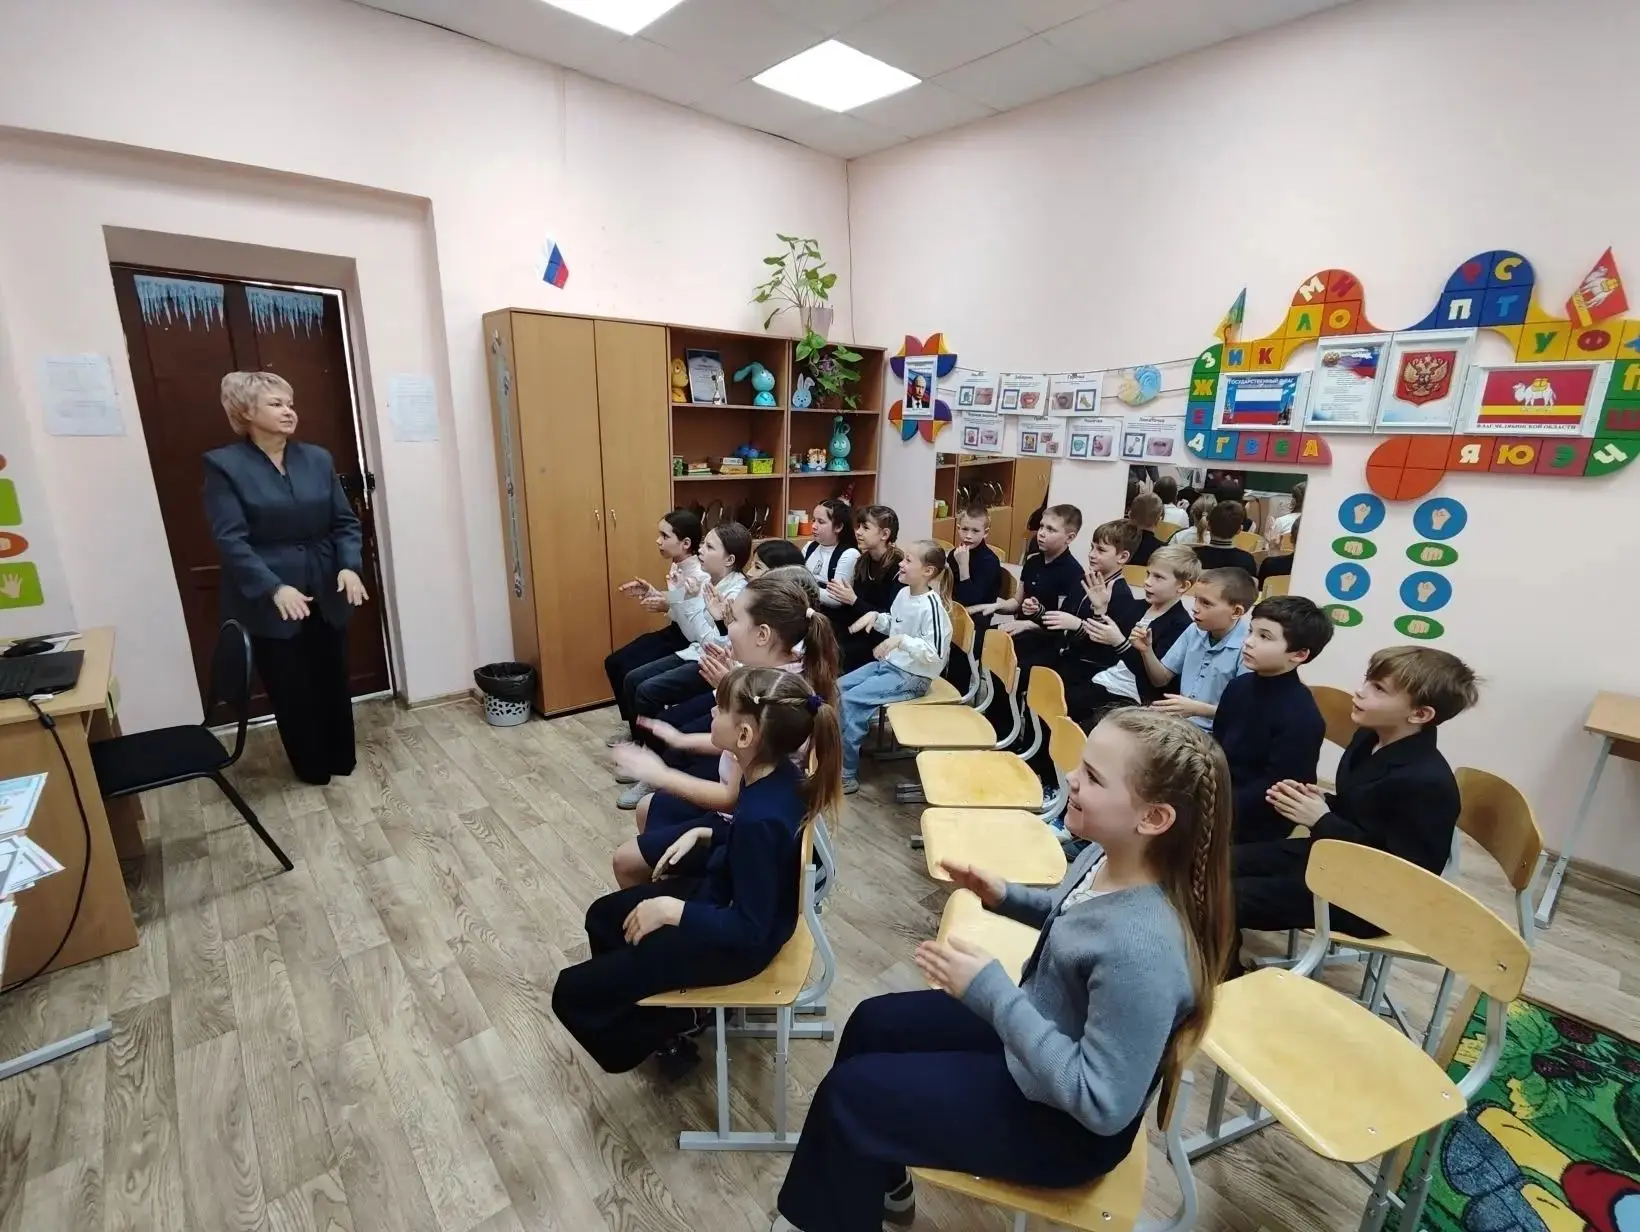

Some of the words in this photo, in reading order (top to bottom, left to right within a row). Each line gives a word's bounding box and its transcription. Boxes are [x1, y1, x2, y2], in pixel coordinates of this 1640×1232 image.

[1494, 257, 1523, 281] С
[1300, 276, 1325, 302] М
[1448, 298, 1472, 320] П
[1497, 295, 1520, 318] Т
[1328, 309, 1351, 329] О
[1534, 331, 1558, 354] У
[1577, 329, 1611, 351] Ф
[1202, 351, 1216, 368] З
[1228, 349, 1243, 366] И
[1258, 347, 1273, 364] К
[1192, 379, 1213, 396] Ж
[1192, 407, 1205, 423] Е
[1216, 436, 1230, 453] Г
[1303, 439, 1319, 457] А
[1459, 443, 1482, 464] Я
[1496, 443, 1534, 465] Ю
[1551, 445, 1576, 468] Э
